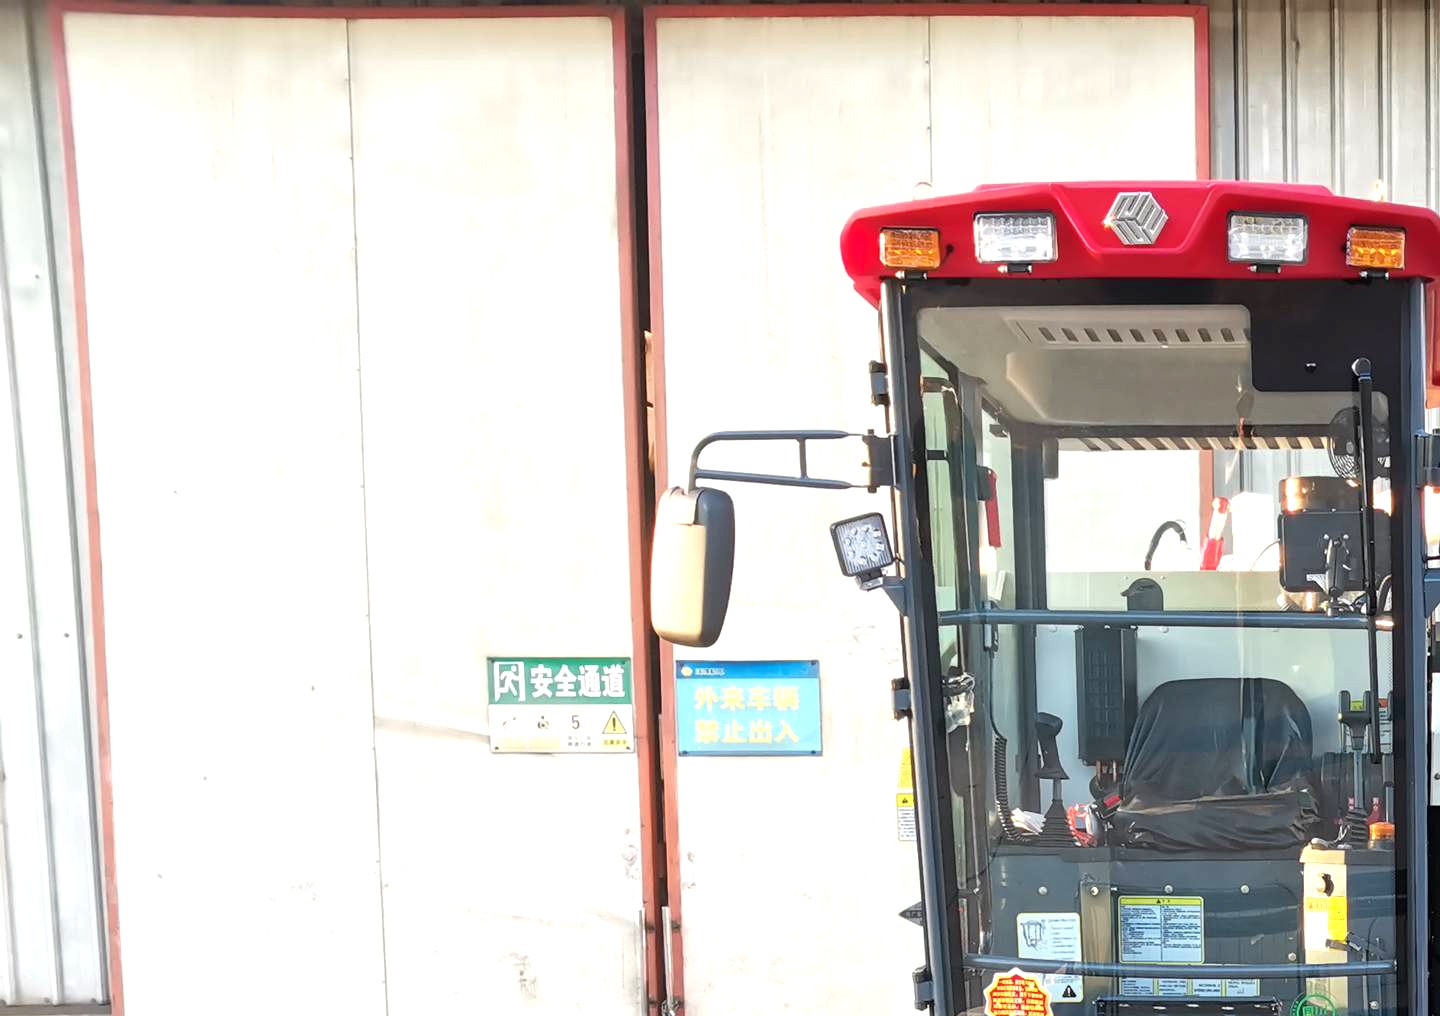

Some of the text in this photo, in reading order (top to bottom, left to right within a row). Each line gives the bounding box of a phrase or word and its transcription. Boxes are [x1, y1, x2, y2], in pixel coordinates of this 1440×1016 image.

[529, 663, 626, 699] 安全通道
[694, 685, 800, 712] 外来车辆
[571, 714, 581, 730] 5
